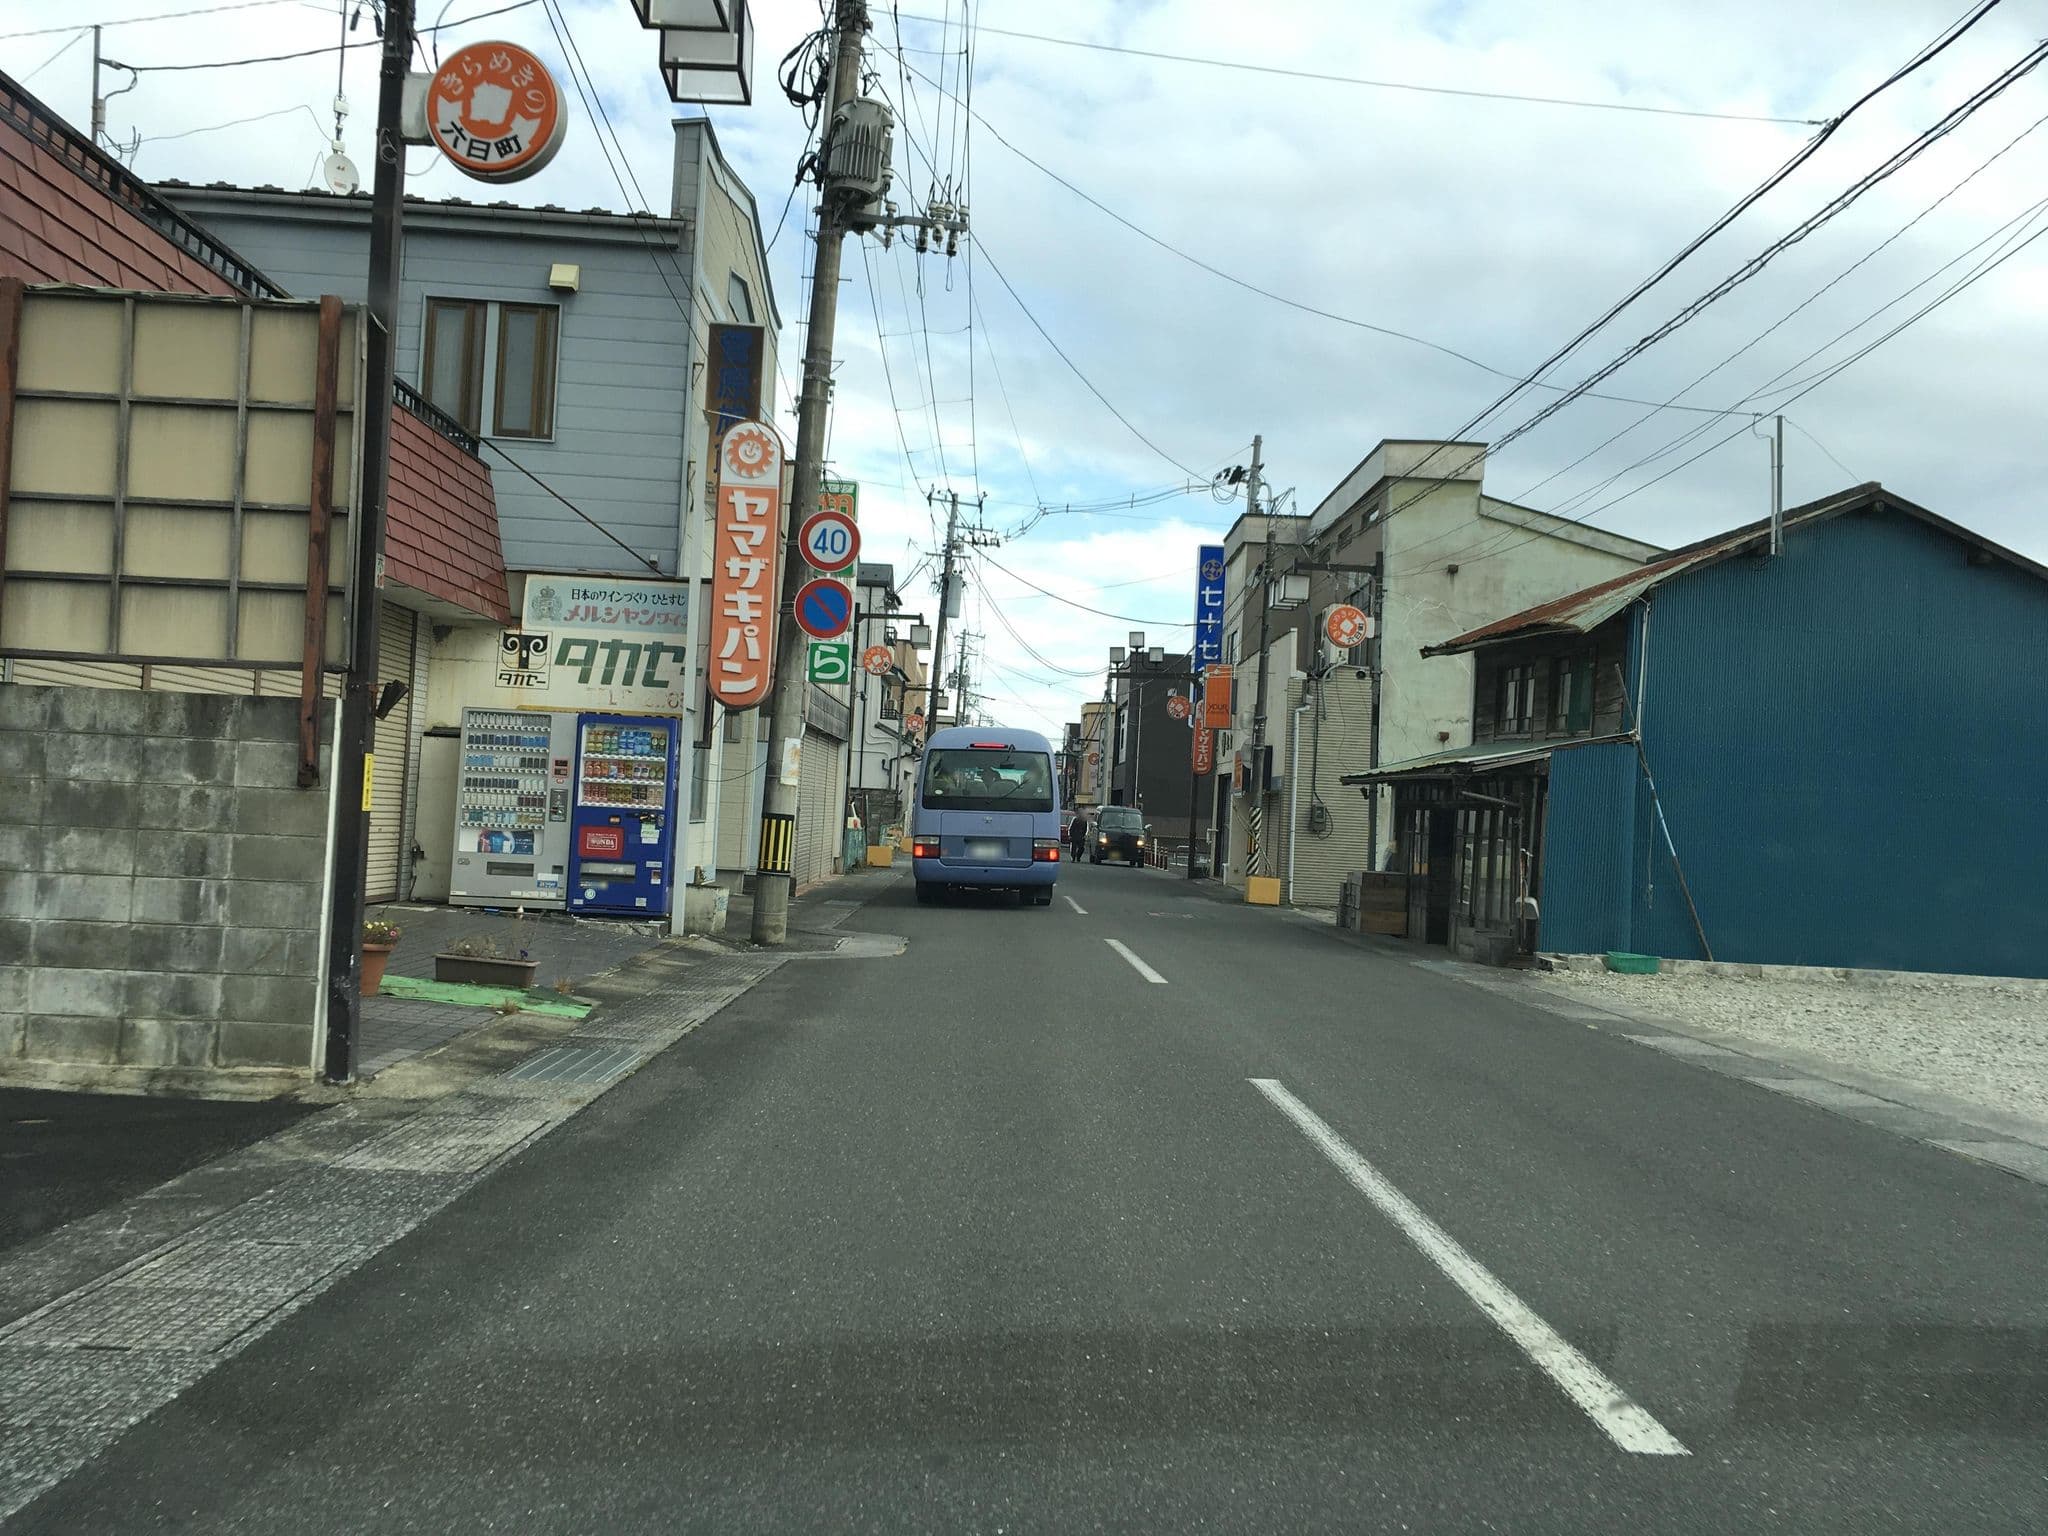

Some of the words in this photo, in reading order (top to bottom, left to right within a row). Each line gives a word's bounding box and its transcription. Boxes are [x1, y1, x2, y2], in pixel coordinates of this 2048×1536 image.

[441, 50, 547, 113] きらめきの
[440, 120, 523, 162] 六日町
[813, 528, 847, 555] 40
[570, 588, 648, 605] 日本のワインづくり
[651, 593, 686, 607] ひとすじ
[719, 489, 769, 695] ヤマザキパン
[1197, 585, 1224, 672] 七十七
[498, 672, 547, 687] タカセー
[813, 645, 846, 680] ら
